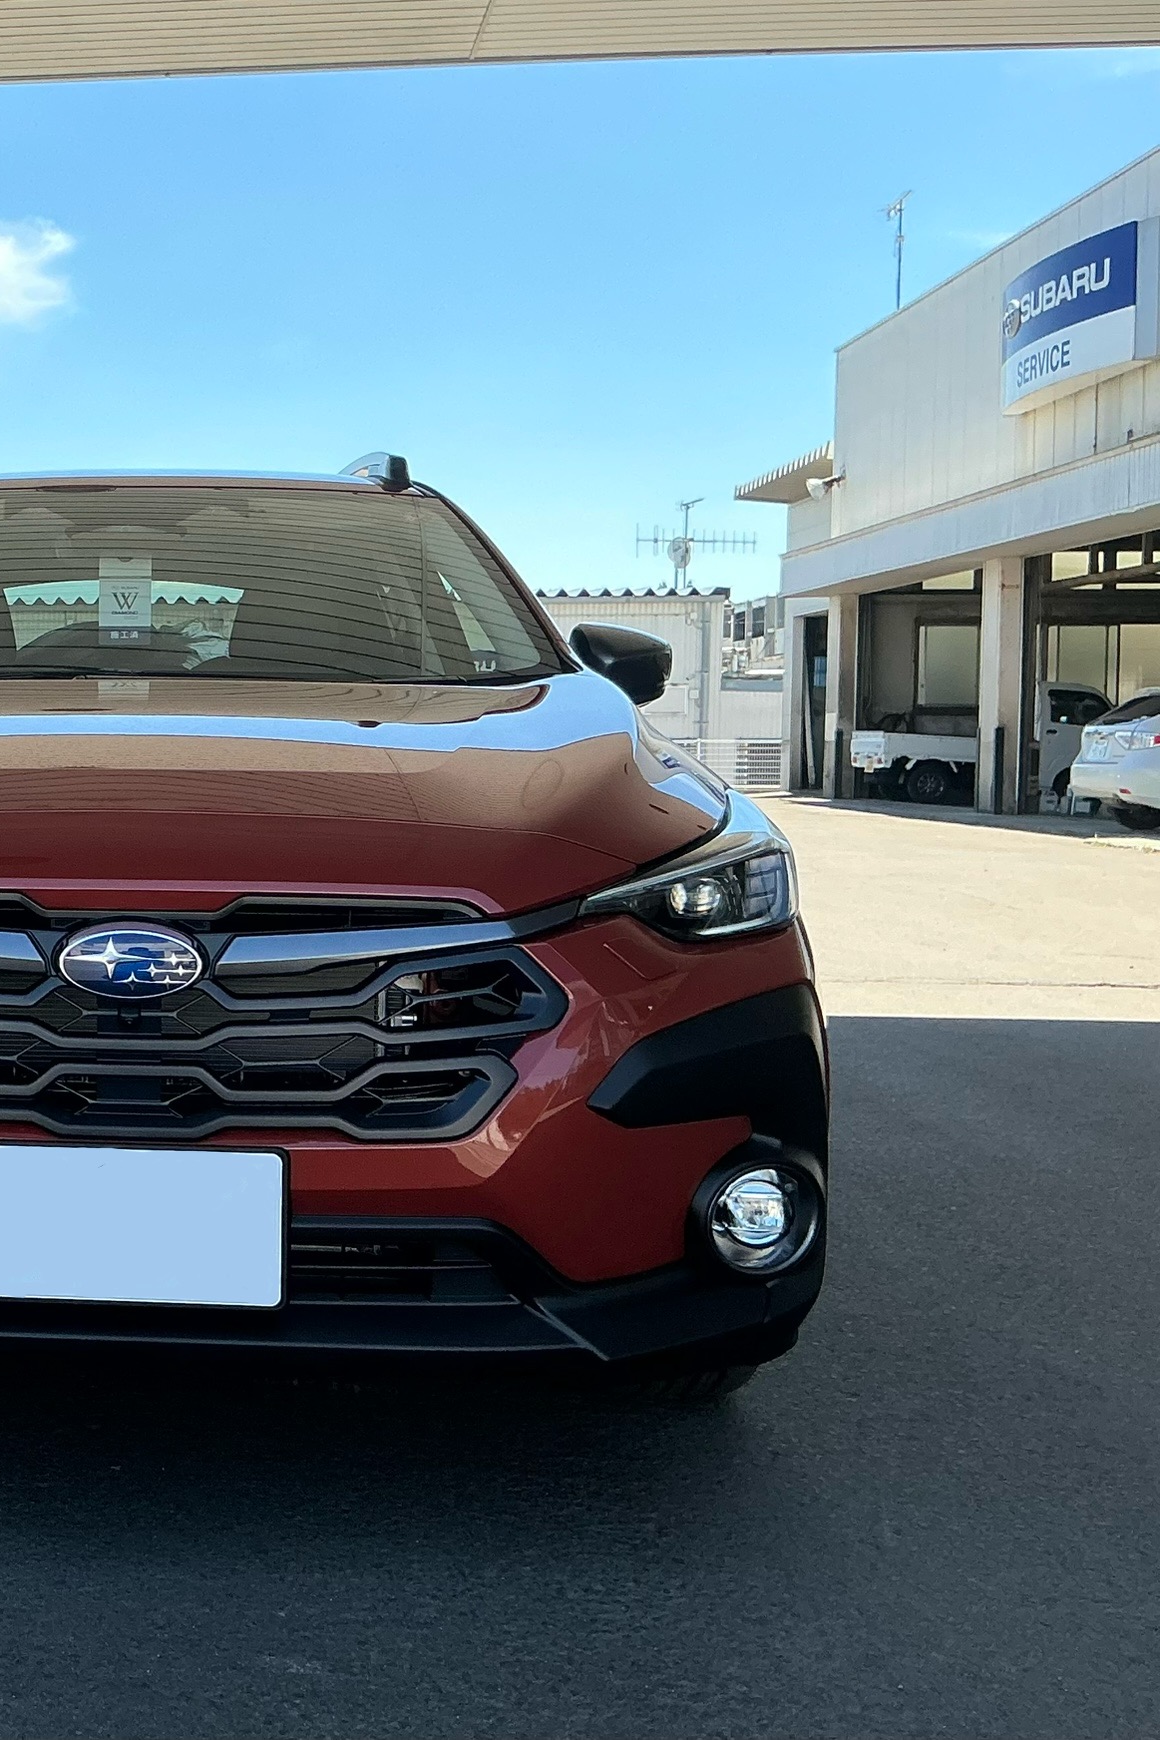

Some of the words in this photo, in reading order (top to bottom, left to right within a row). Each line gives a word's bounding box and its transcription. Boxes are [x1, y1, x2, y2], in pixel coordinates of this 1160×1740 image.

[1020, 257, 1111, 324] SUBARU
[1016, 339, 1071, 389] SERVICE
[111, 592, 140, 611] W
